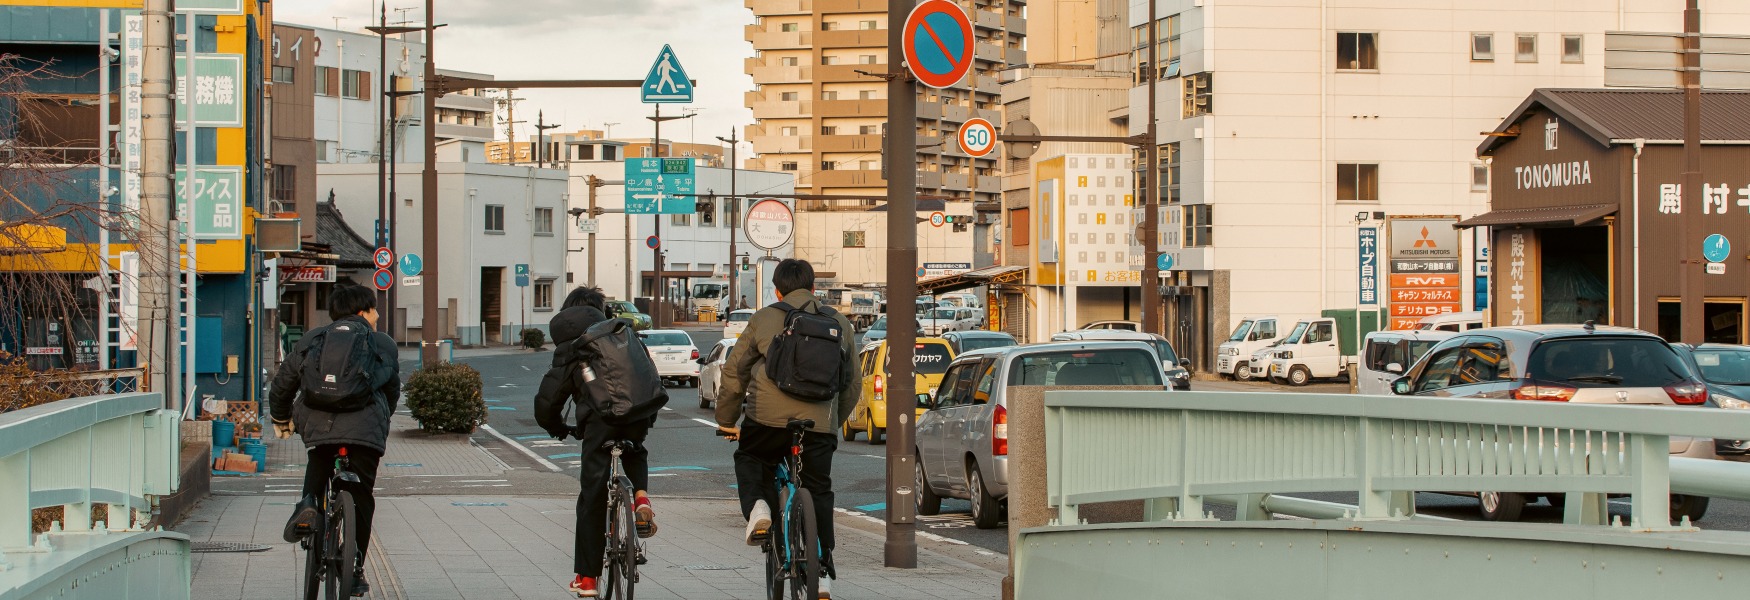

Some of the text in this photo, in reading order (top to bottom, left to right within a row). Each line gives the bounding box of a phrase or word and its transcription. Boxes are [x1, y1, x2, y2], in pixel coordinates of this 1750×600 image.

[967, 128, 988, 146] 50
[1515, 160, 1592, 190] TONOMURA
[752, 211, 789, 220] 和歌山バス
[933, 215, 942, 224] 50
[1360, 236, 1375, 302] ホープ自動車
[1406, 277, 1445, 285] RVR
[1398, 291, 1452, 300] ギャラン フォルティス
[1398, 306, 1423, 315] デリカ
